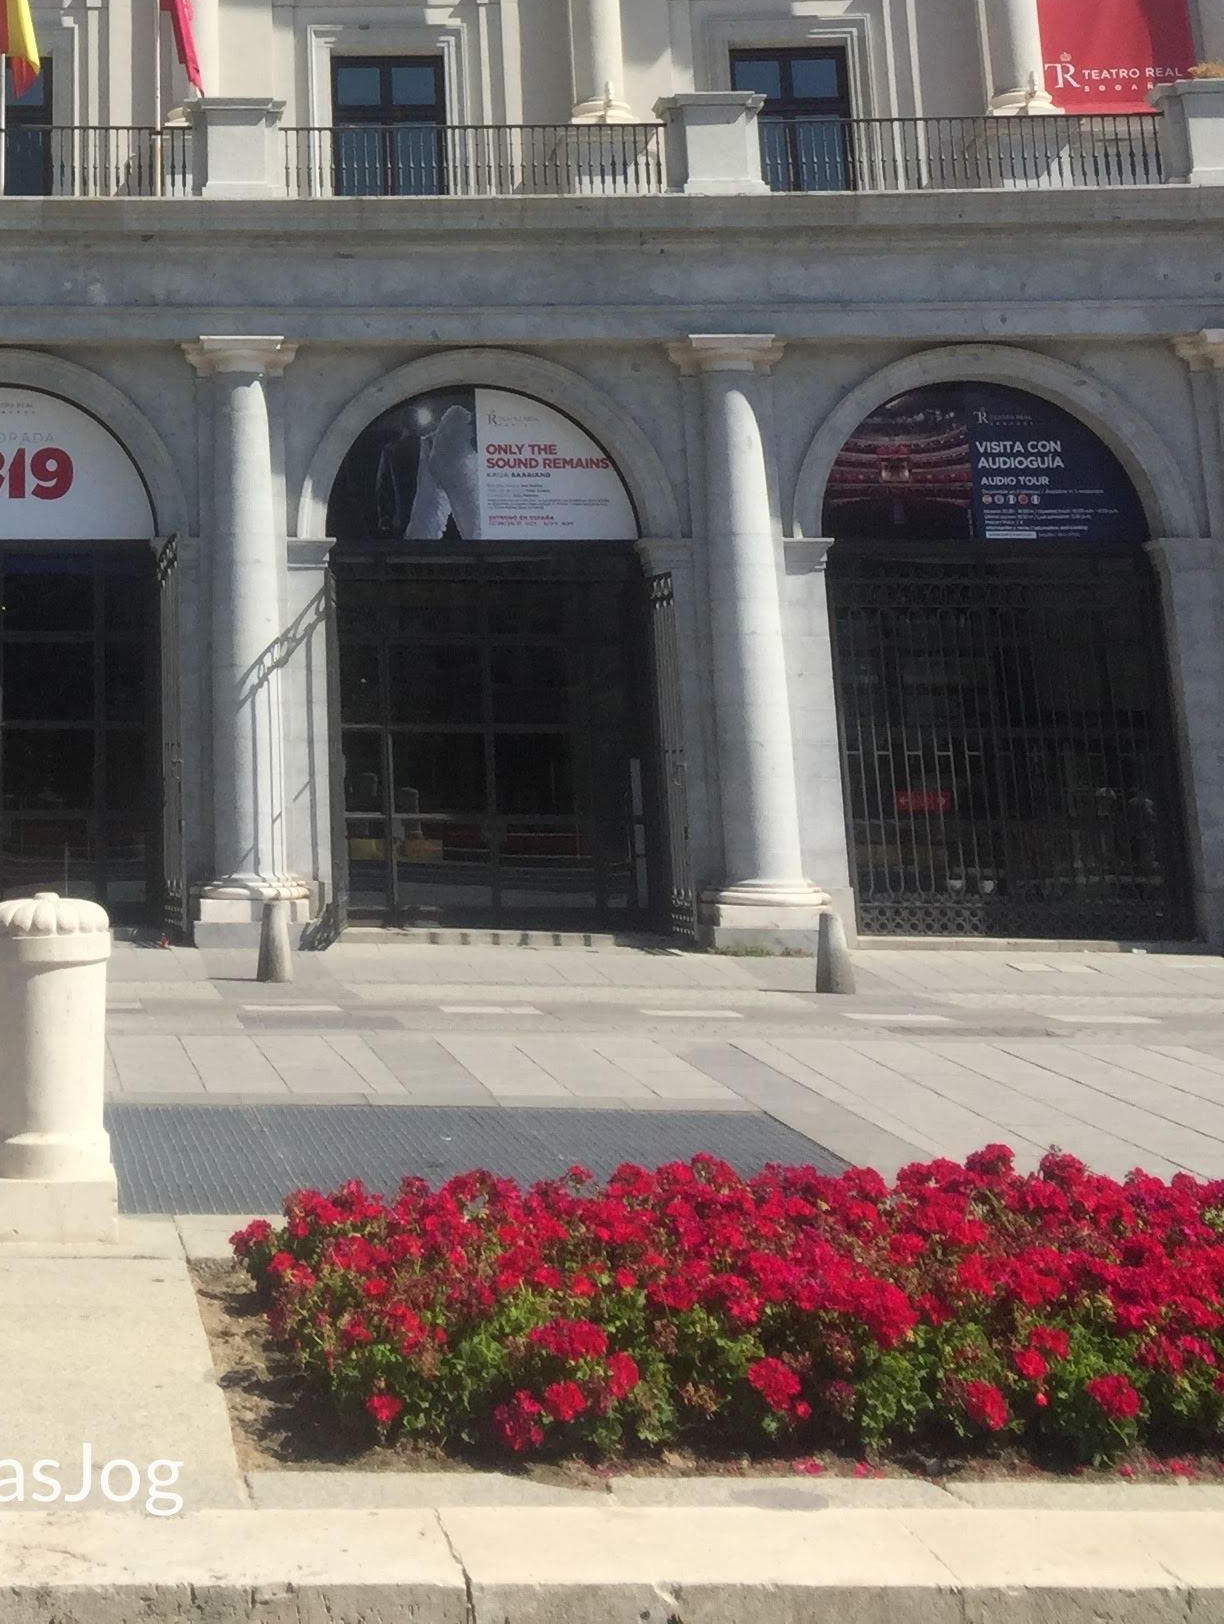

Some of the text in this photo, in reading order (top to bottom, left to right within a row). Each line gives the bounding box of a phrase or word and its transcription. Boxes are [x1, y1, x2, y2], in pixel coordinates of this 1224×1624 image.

[1082, 67, 1184, 80] TEATRO REAL
[485, 443, 558, 455] ONLY THE
[976, 440, 1062, 453] VISITA CON
[486, 457, 610, 469] SOUND REMAINS
[978, 453, 1065, 469] AUDIOGUÍA
[981, 477, 1050, 486] AUDIO TOUR
